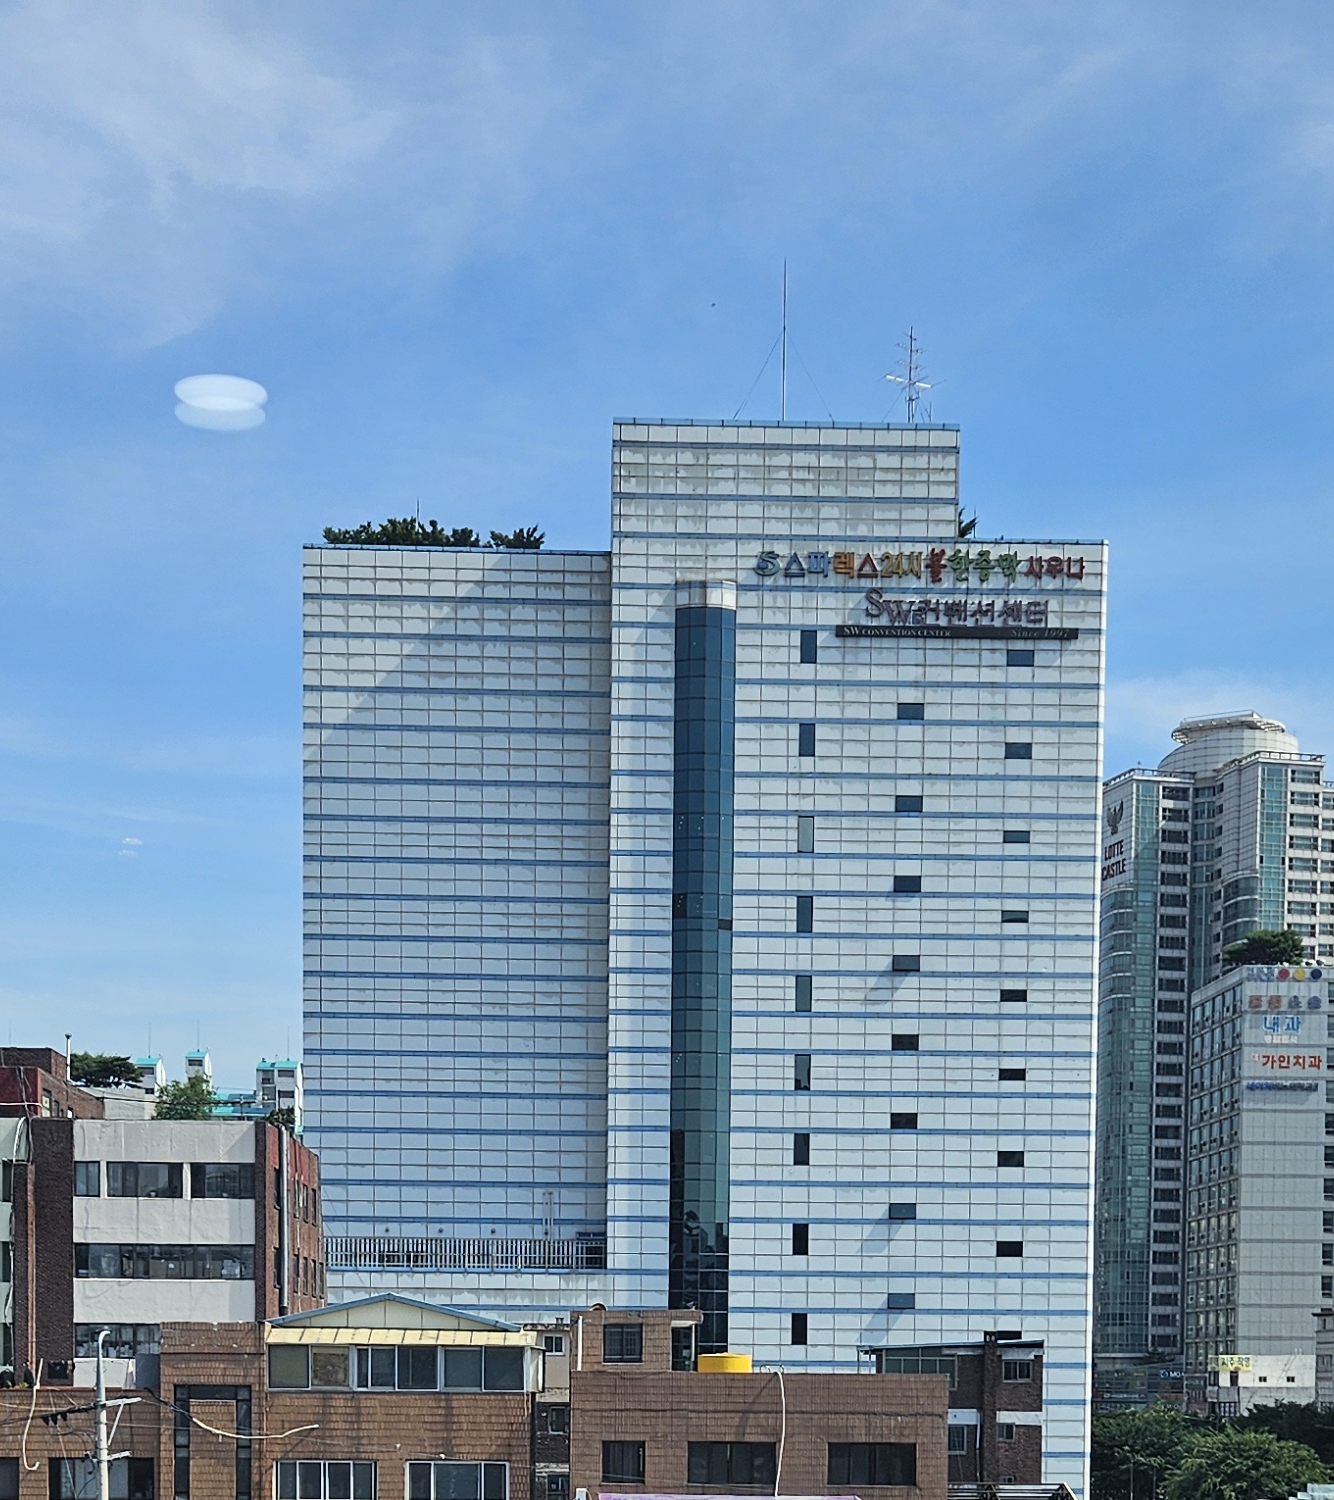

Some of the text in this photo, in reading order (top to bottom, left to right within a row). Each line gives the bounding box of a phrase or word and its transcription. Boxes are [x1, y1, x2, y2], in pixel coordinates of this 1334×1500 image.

[1025, 556, 1084, 580] 사우나
[861, 628, 915, 636] CONVENTION
[917, 628, 952, 637] CENTER
[1011, 628, 1040, 638] Since
[1043, 628, 1070, 638] 1997
[1104, 839, 1124, 861] LOTTE
[1101, 858, 1127, 881] CASTLE
[1263, 1015, 1301, 1034] 내과
[1262, 1055, 1322, 1070] 가인치과
